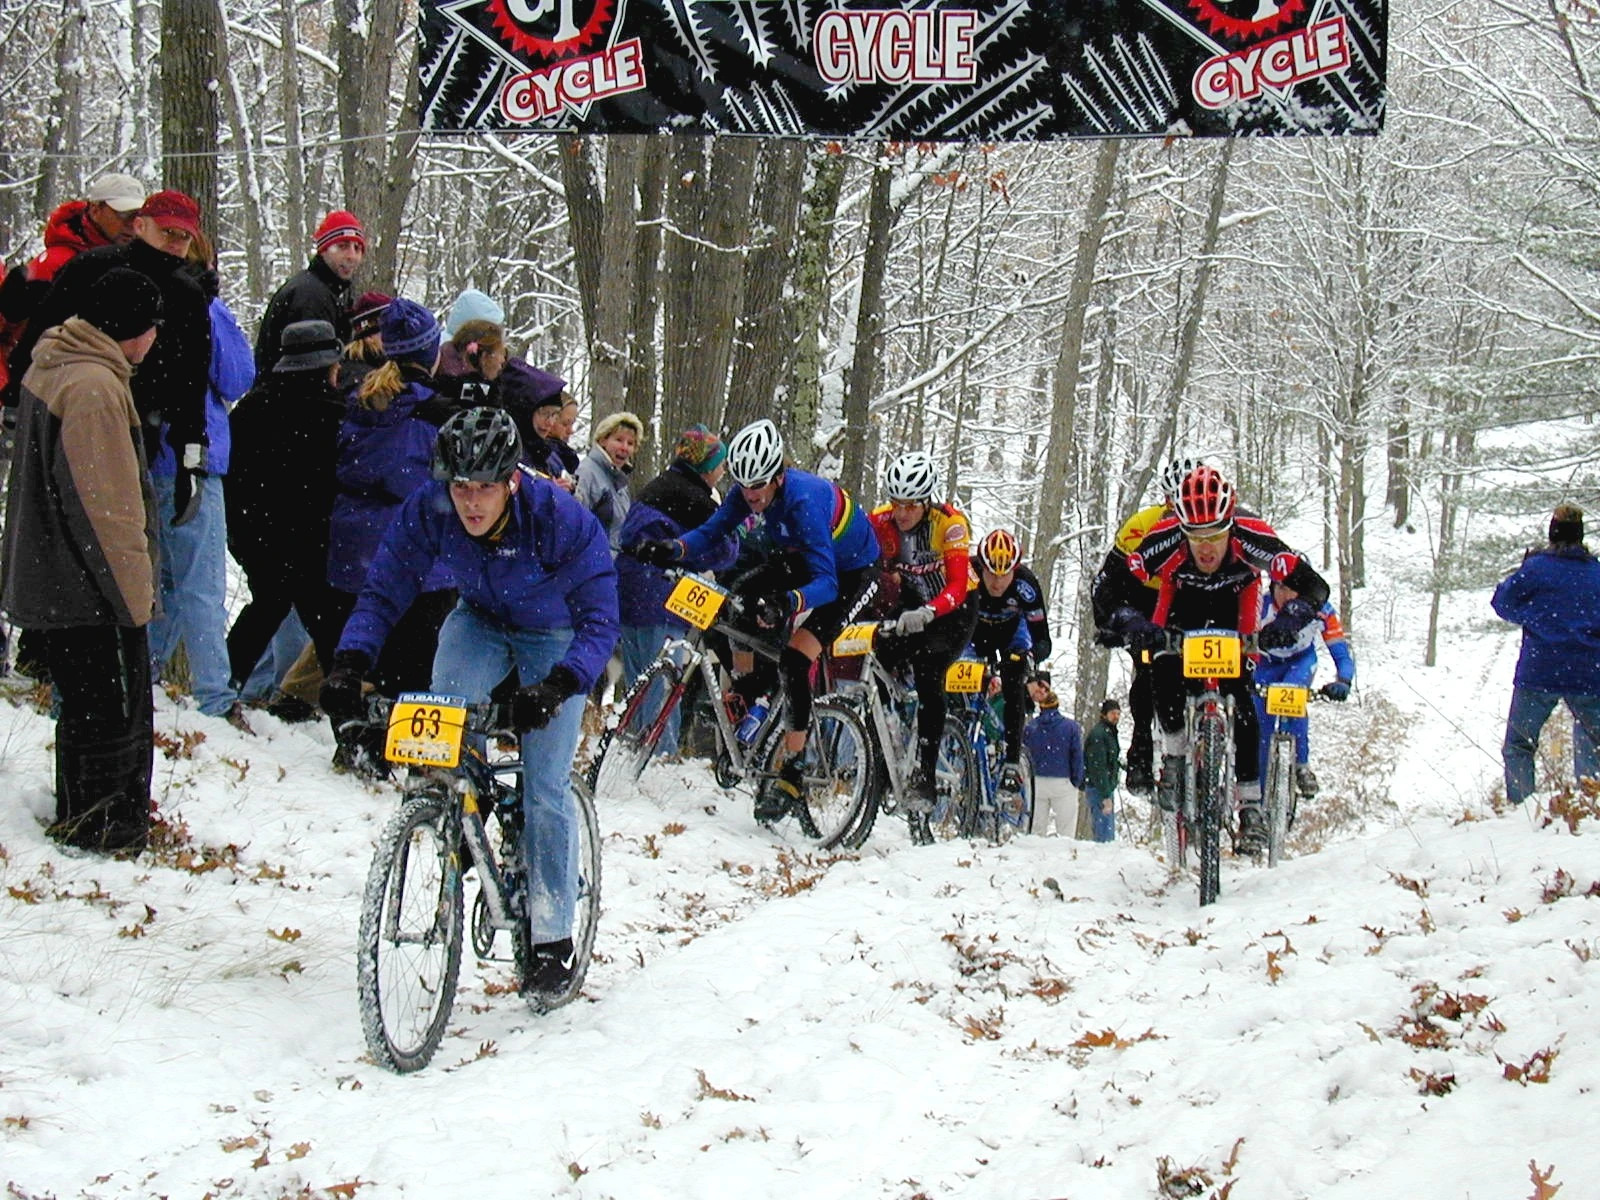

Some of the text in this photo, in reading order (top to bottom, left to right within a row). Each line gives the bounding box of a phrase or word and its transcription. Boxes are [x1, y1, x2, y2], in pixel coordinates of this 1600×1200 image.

[815, 12, 975, 81] CYCLE
[1196, 19, 1346, 106] CYCLE
[503, 42, 642, 120] CYCLE
[686, 585, 709, 608] 66
[670, 602, 705, 625] ICEMAN
[846, 626, 864, 641] 27
[1203, 639, 1221, 659] 51
[957, 663, 973, 680] 34
[1189, 667, 1235, 675] ICEMAN
[402, 694, 451, 704] SUBARU
[1280, 688, 1295, 704] 24
[1271, 707, 1303, 715] ICEMAN
[411, 708, 441, 739] 63
